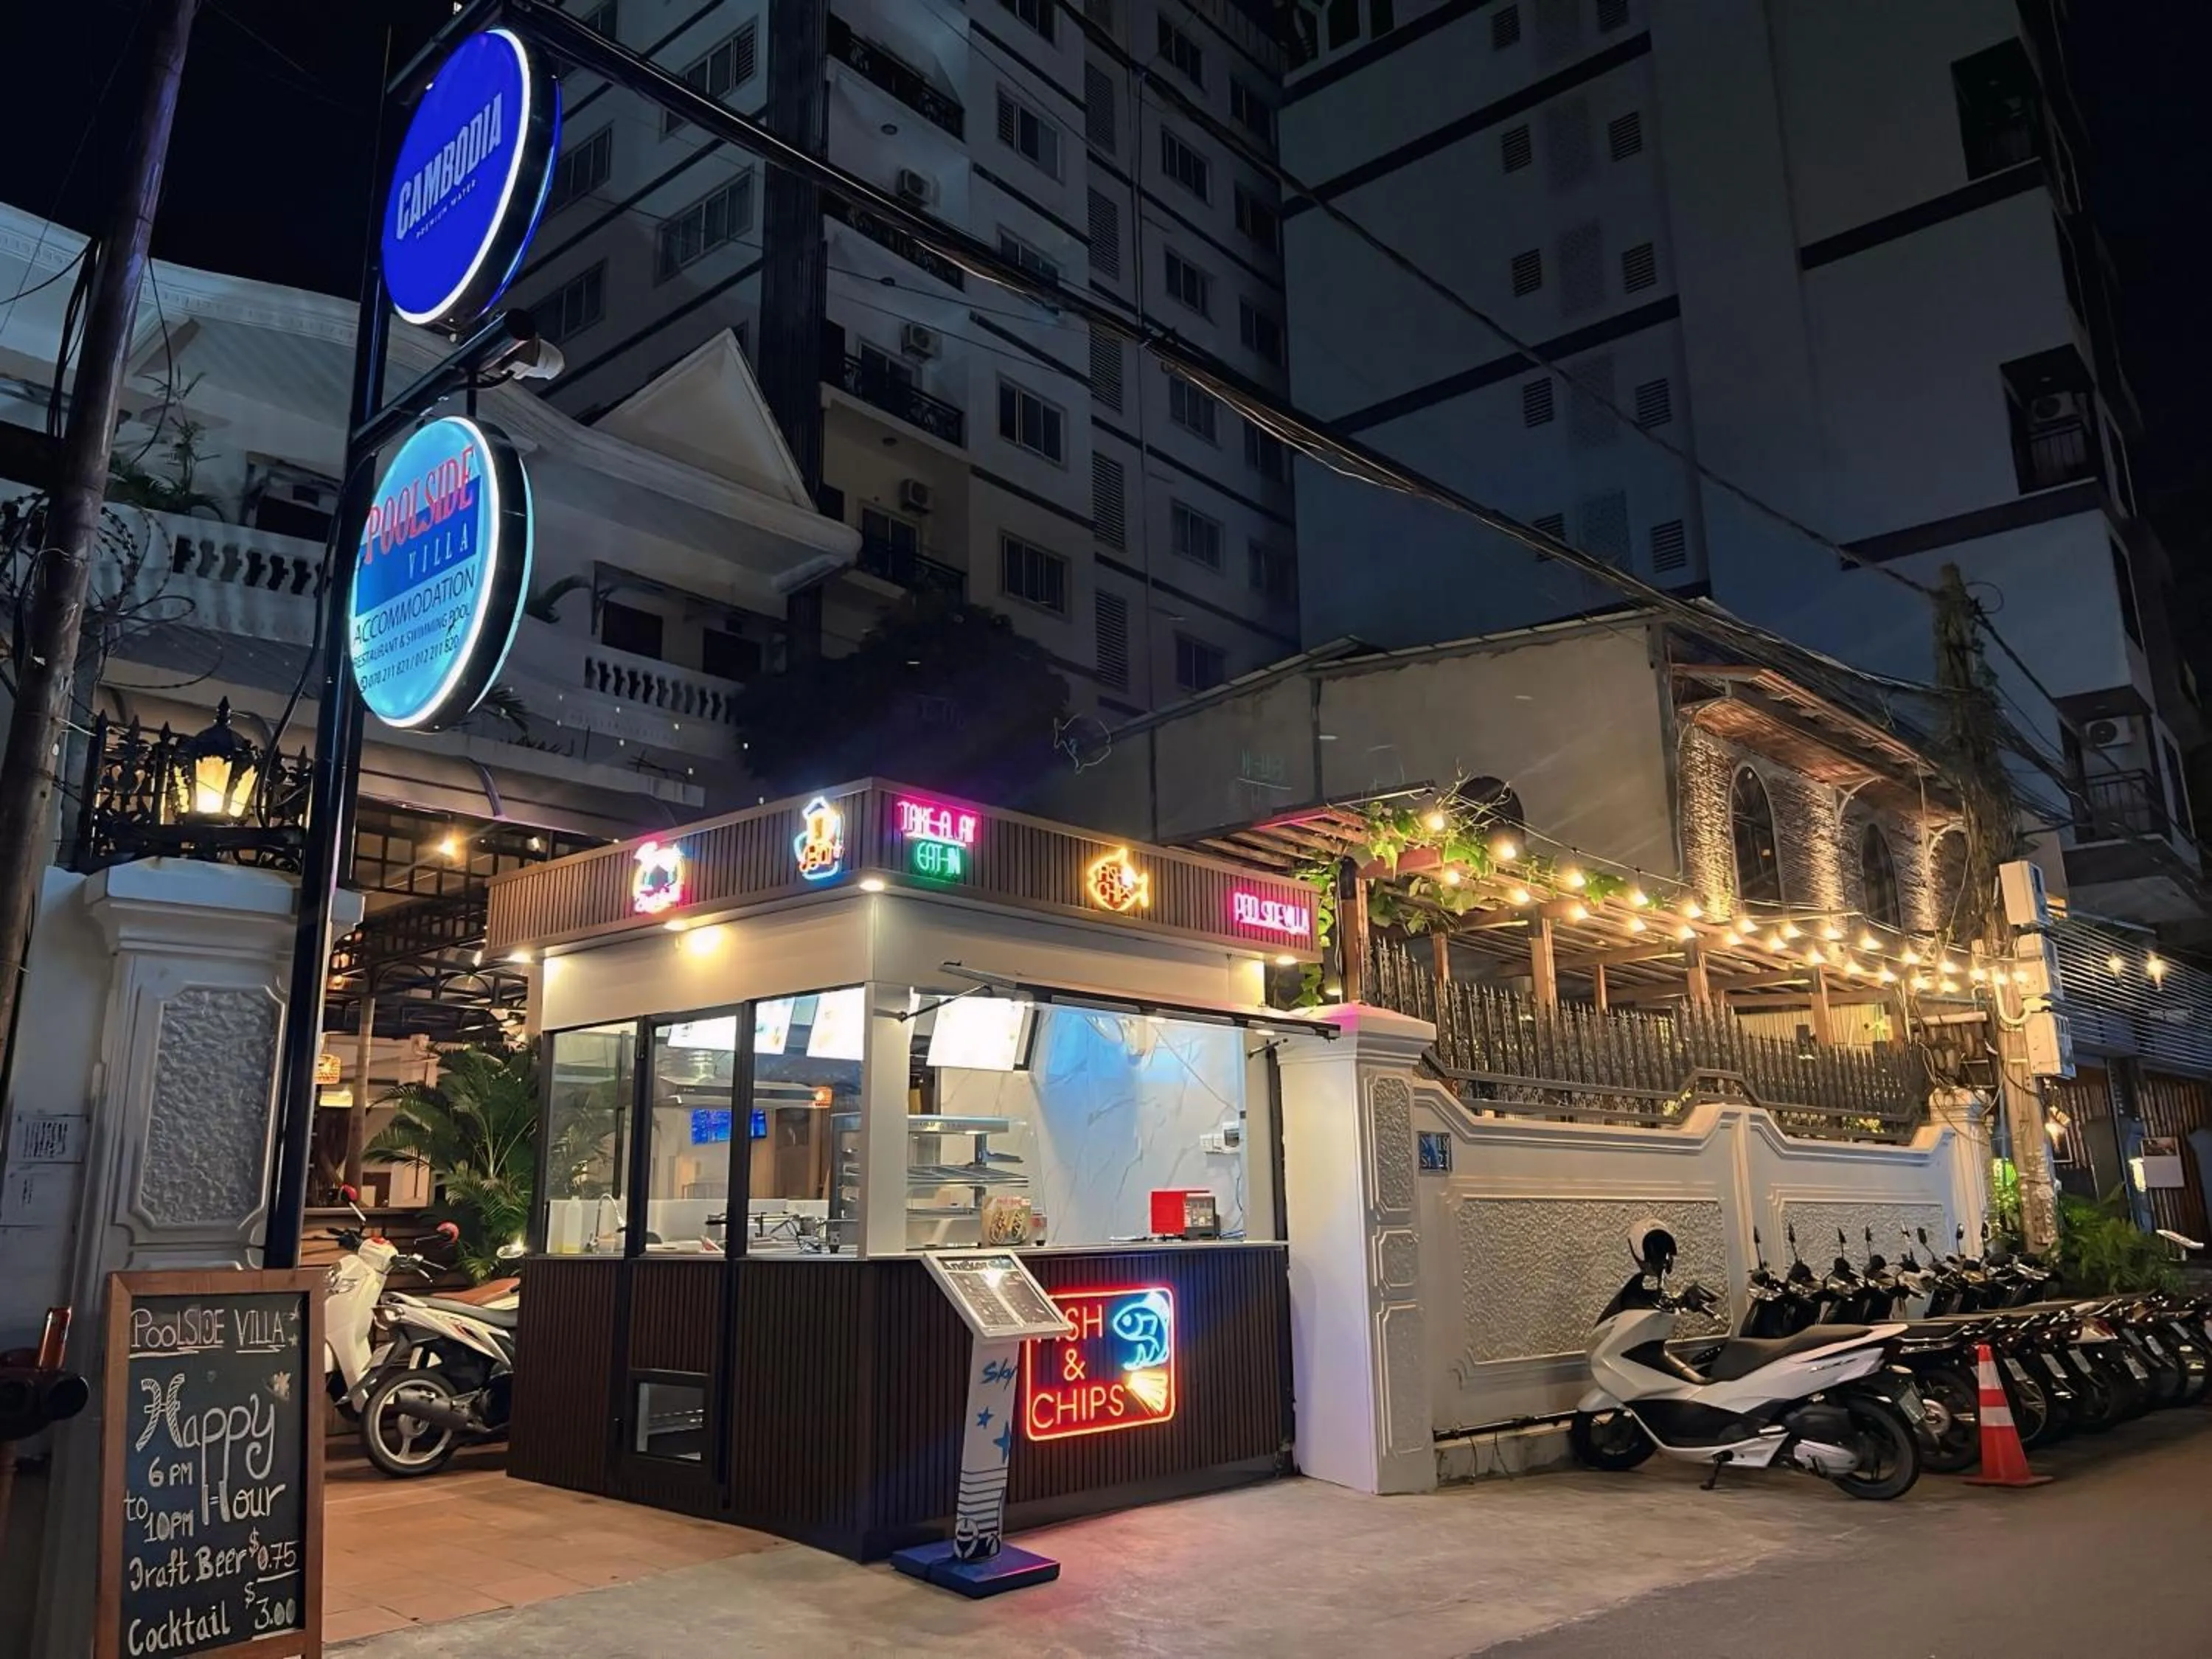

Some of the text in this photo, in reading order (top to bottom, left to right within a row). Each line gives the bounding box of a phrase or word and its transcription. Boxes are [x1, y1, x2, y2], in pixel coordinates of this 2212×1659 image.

[396, 92, 503, 240] CAMBODIA
[364, 445, 475, 566] POOLSIDE
[408, 521, 469, 578] VILLA
[352, 563, 476, 645] ACCOMMODATION
[897, 800, 976, 843] TAKE-AAY
[234, 1309, 285, 1347] VILLA
[1063, 1349, 1085, 1381] &
[136, 1373, 275, 1481] Happy
[1032, 1383, 1125, 1429] CHIPS
[124, 1489, 148, 1521] to
[201, 1481, 287, 1526] Hour
[128, 1548, 191, 1592] Draft
[195, 1545, 247, 1585] Beer
[128, 1599, 231, 1656] Cocktail
